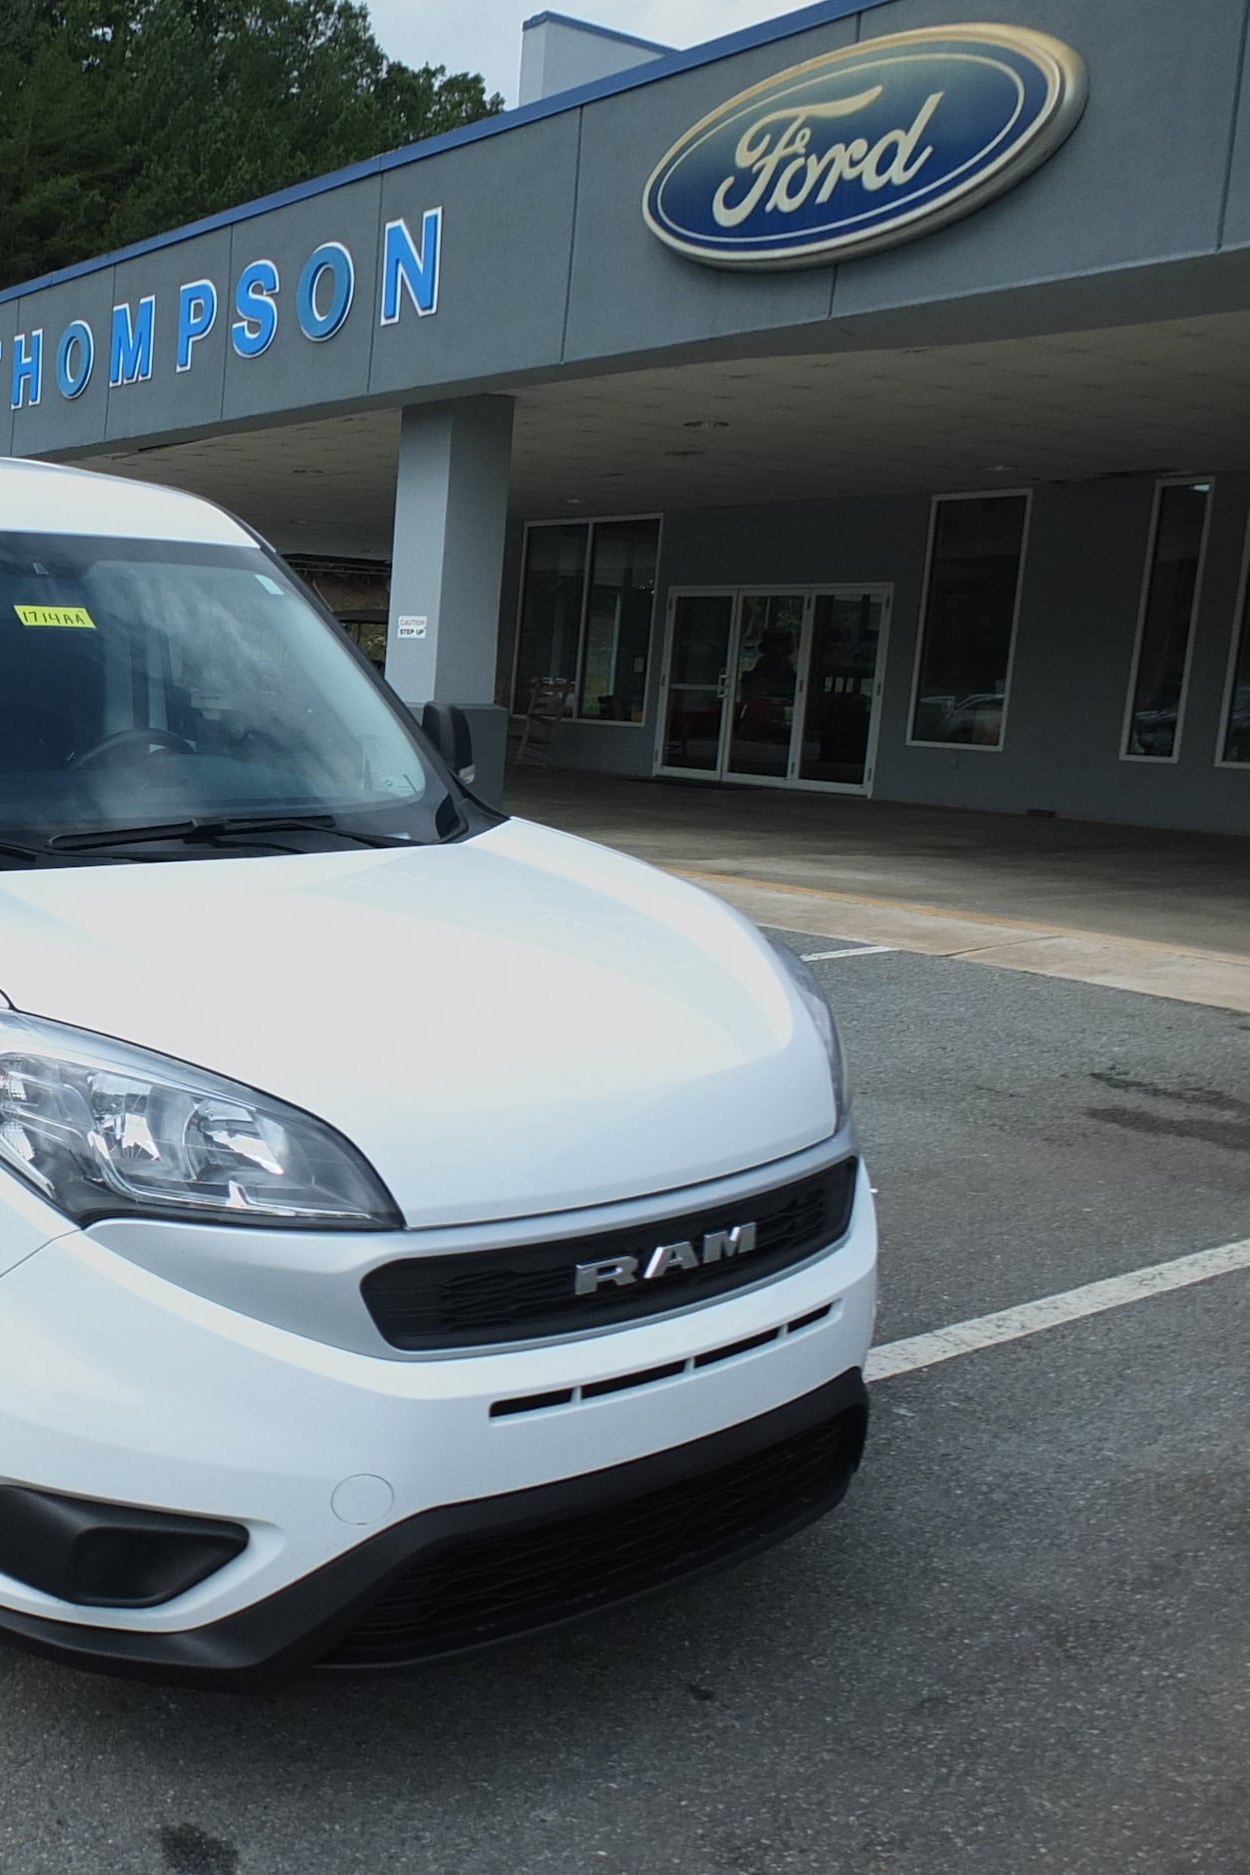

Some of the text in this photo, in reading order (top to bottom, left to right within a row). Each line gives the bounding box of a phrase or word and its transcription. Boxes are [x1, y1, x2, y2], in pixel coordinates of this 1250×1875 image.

[712, 85, 944, 227] Ford
[22, 610, 86, 625] 1714AA
[399, 628, 415, 636] STEP
[574, 1221, 757, 1296] RAM
